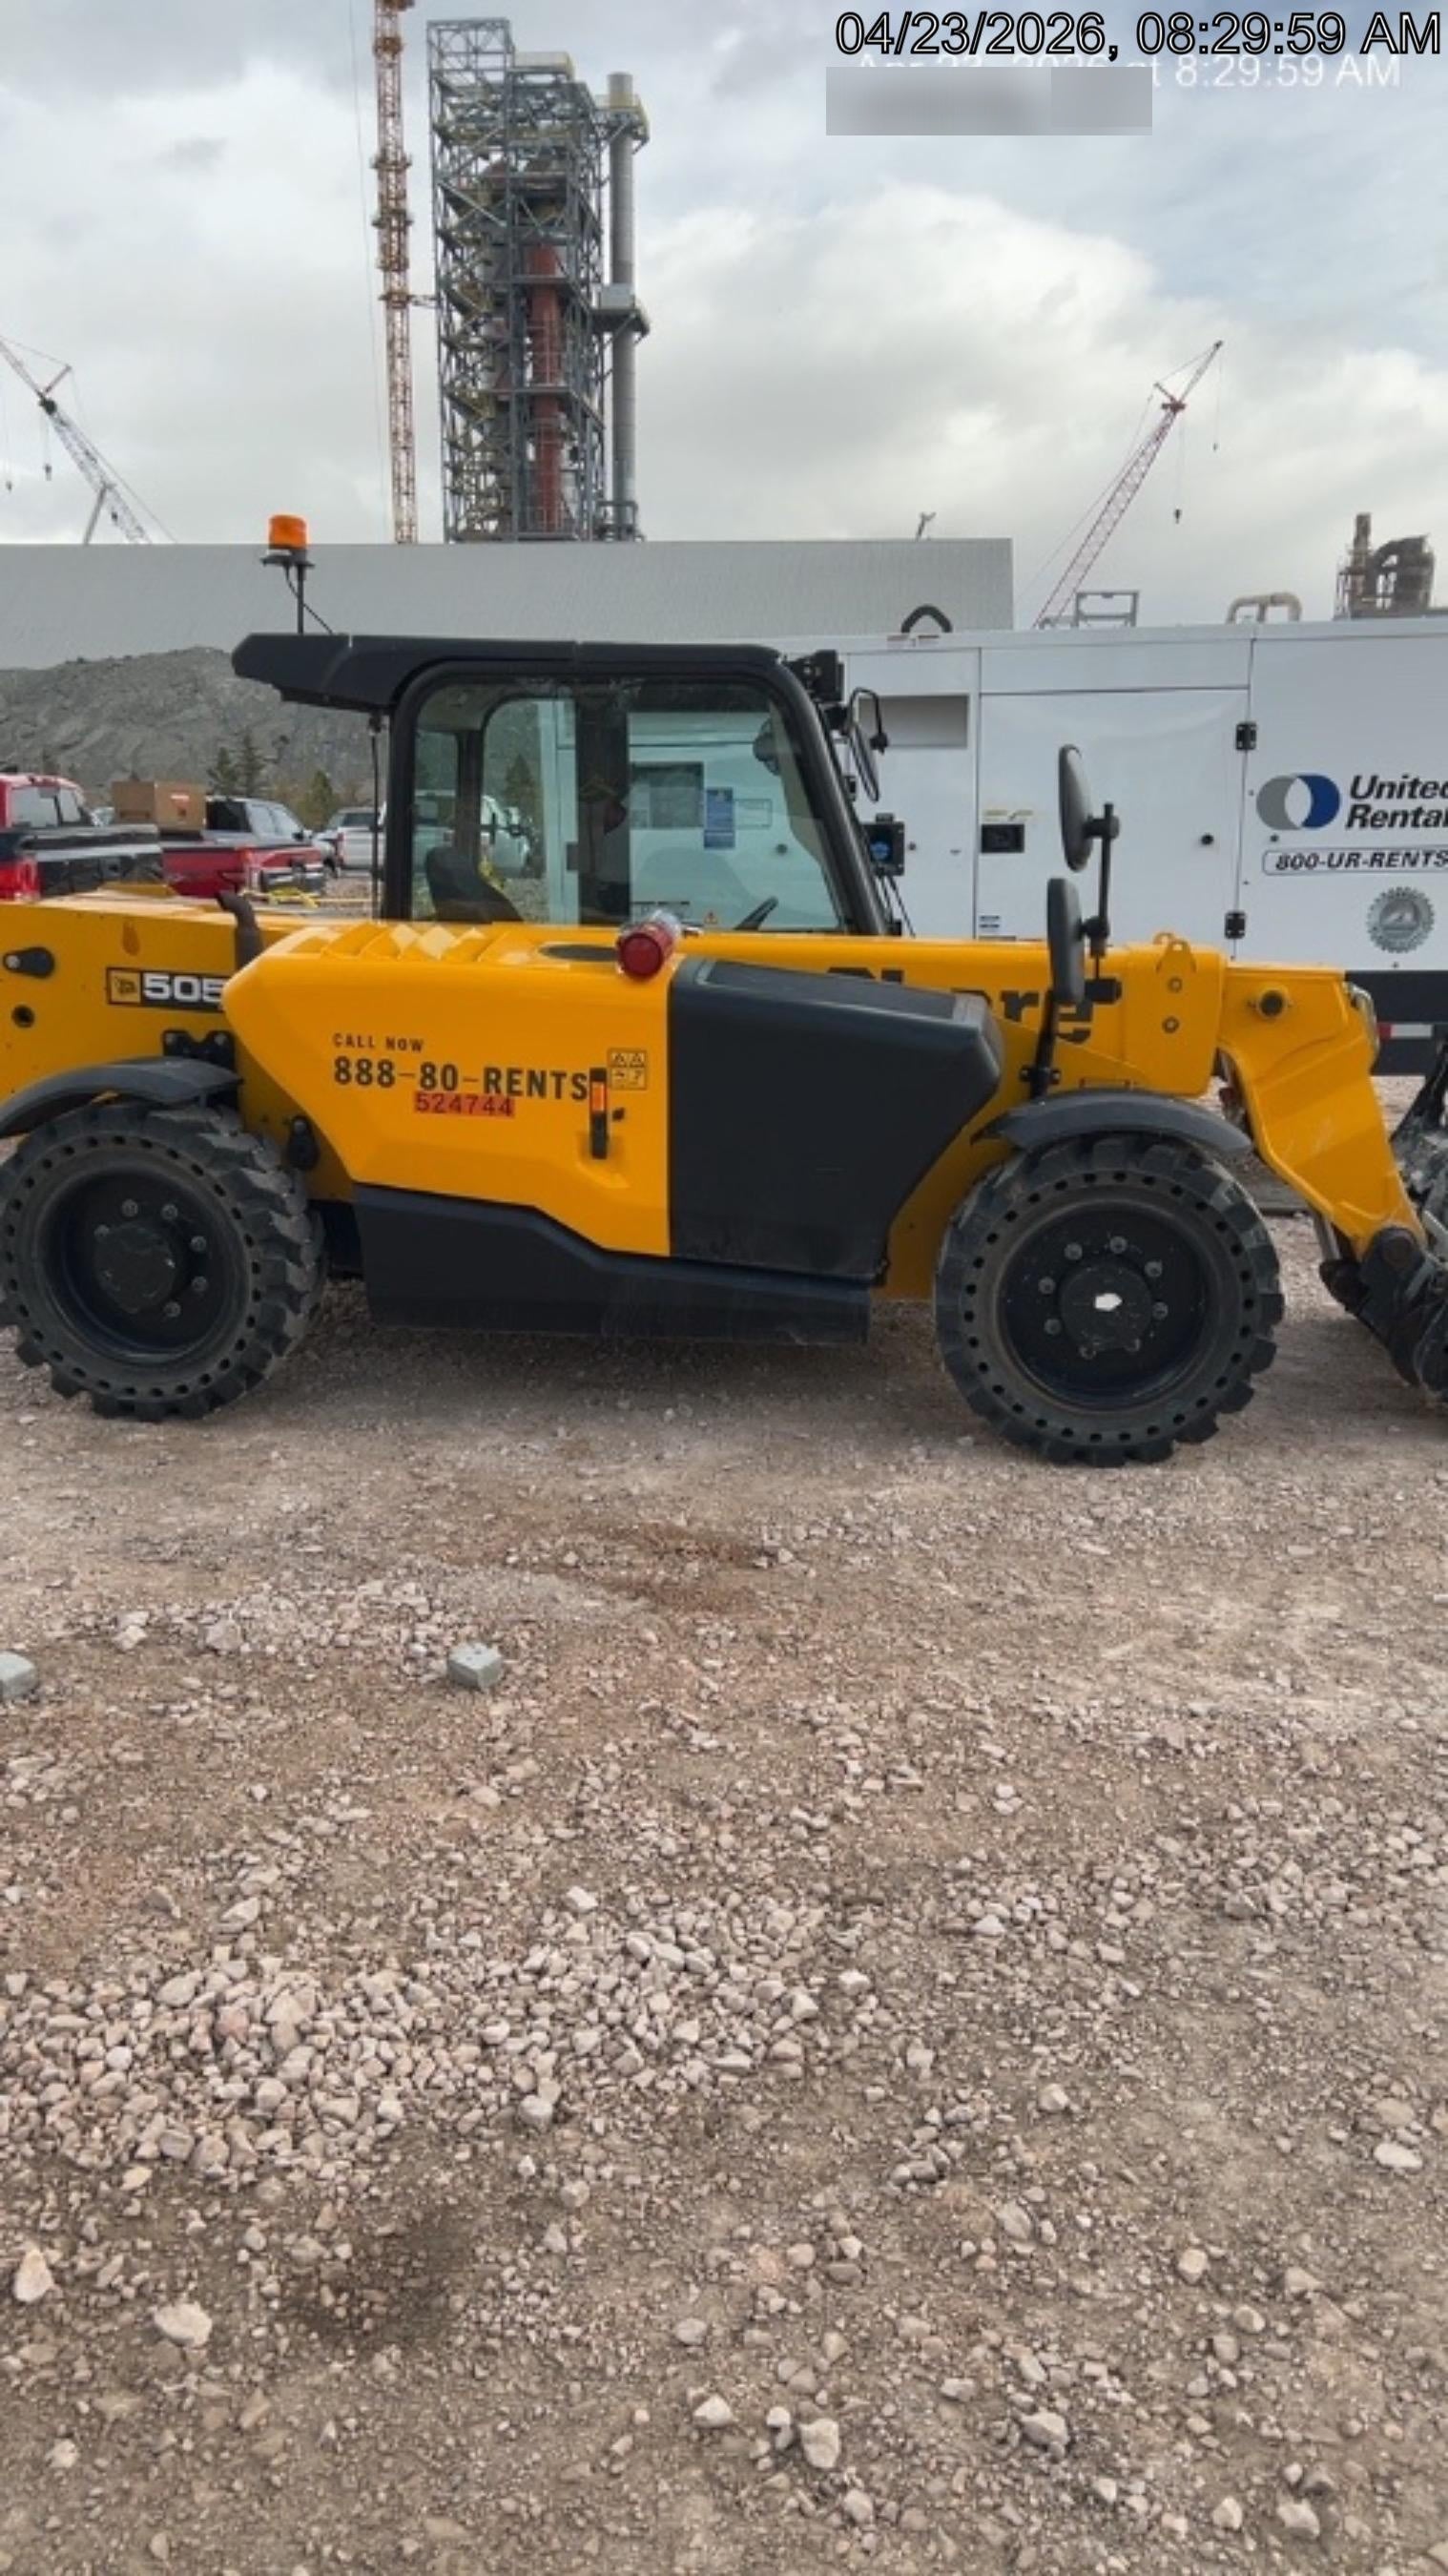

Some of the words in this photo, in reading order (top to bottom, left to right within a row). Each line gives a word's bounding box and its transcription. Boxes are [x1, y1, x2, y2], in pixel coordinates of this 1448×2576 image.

[332, 1033, 375, 1049] CALL
[385, 1036, 424, 1052] NOW
[334, 1055, 588, 1101] 888-80-RENTS
[416, 1092, 512, 1116] 524744
